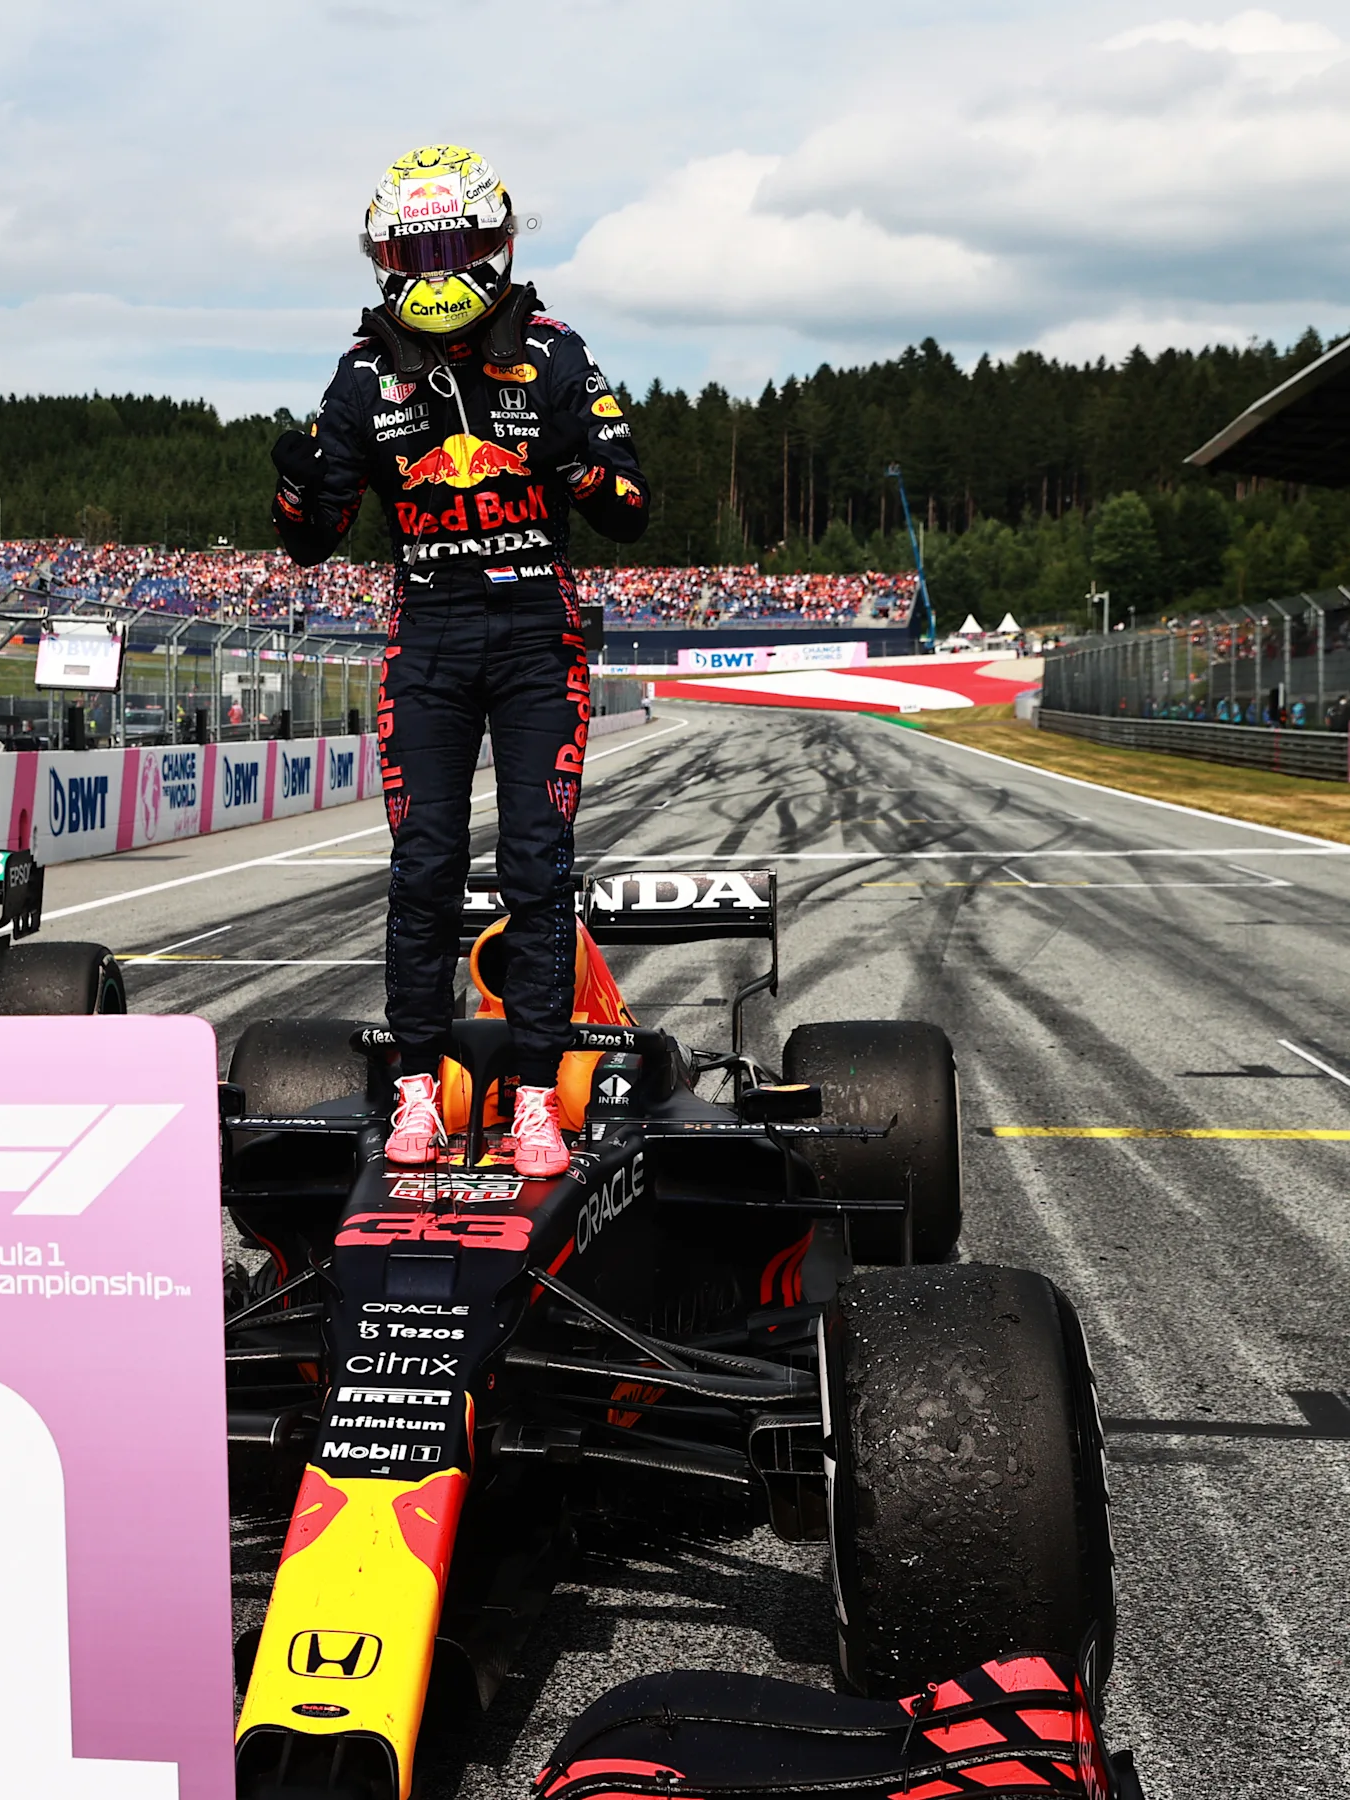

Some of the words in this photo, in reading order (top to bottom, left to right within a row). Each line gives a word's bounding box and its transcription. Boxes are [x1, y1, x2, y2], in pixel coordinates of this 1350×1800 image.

[404, 205, 429, 219] Red
[432, 200, 459, 215] Bull
[394, 218, 472, 237] HONDA
[410, 298, 472, 316] CarNext
[498, 366, 532, 378] RAUCH
[383, 383, 416, 402] HEUER
[373, 407, 413, 430] Mobil
[490, 411, 538, 420] HONDA
[376, 420, 430, 442] ORACLE
[394, 494, 469, 536] Red
[474, 485, 549, 530] Bull
[403, 529, 552, 562] HONDA
[519, 564, 554, 578] MAX
[710, 653, 755, 668] BWT
[162, 753, 196, 782] CHANGE
[290, 757, 311, 797] BWT
[337, 752, 354, 788] BWT
[234, 762, 259, 806] BWT
[68, 776, 109, 833] BWT
[169, 783, 197, 809] WORLD
[579, 1029, 622, 1047] Tezos
[598, 1096, 630, 1105] INTER
[407, 1181, 511, 1191] TAG
[576, 1152, 645, 1255] ORACLE
[335, 1212, 534, 1252] 33
[48, 1242, 65, 1266] 1
[362, 1303, 470, 1316] ORACLE
[387, 1323, 465, 1340] Tezos
[346, 1352, 459, 1377] citrix
[337, 1387, 453, 1406] PIRELLI
[330, 1415, 446, 1431] infinitum
[322, 1442, 408, 1461] Mobil
